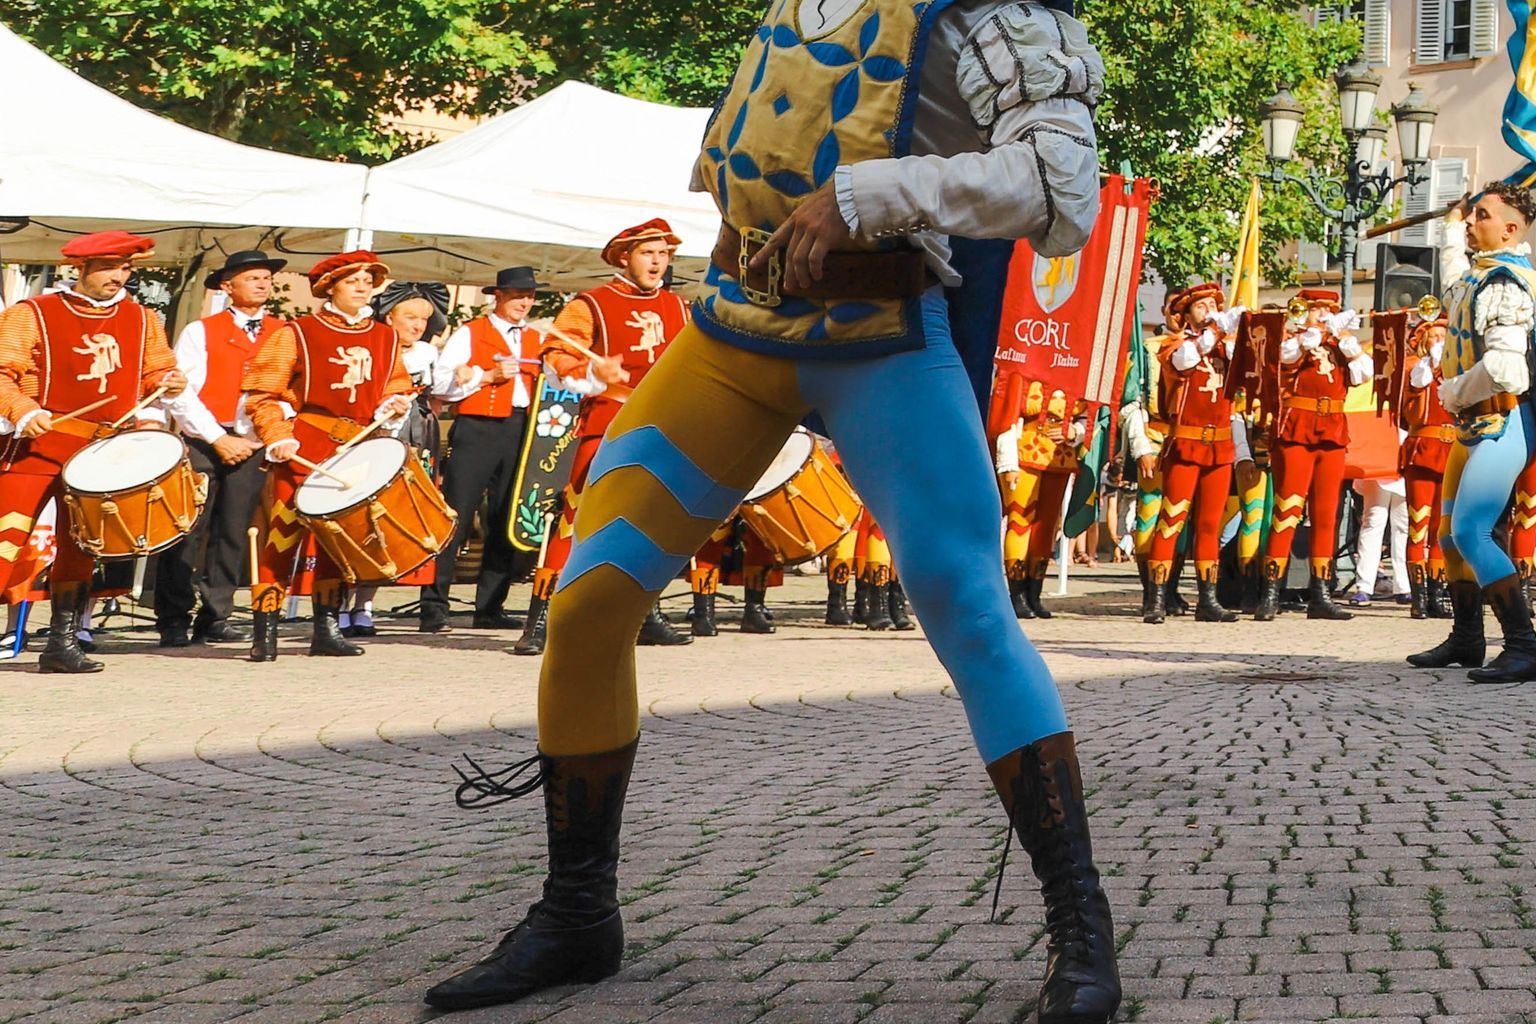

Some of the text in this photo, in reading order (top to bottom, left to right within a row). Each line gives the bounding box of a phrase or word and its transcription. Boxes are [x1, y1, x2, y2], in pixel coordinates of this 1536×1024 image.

[1014, 318, 1071, 350] CORI
[994, 346, 1080, 368] Latina Italia
